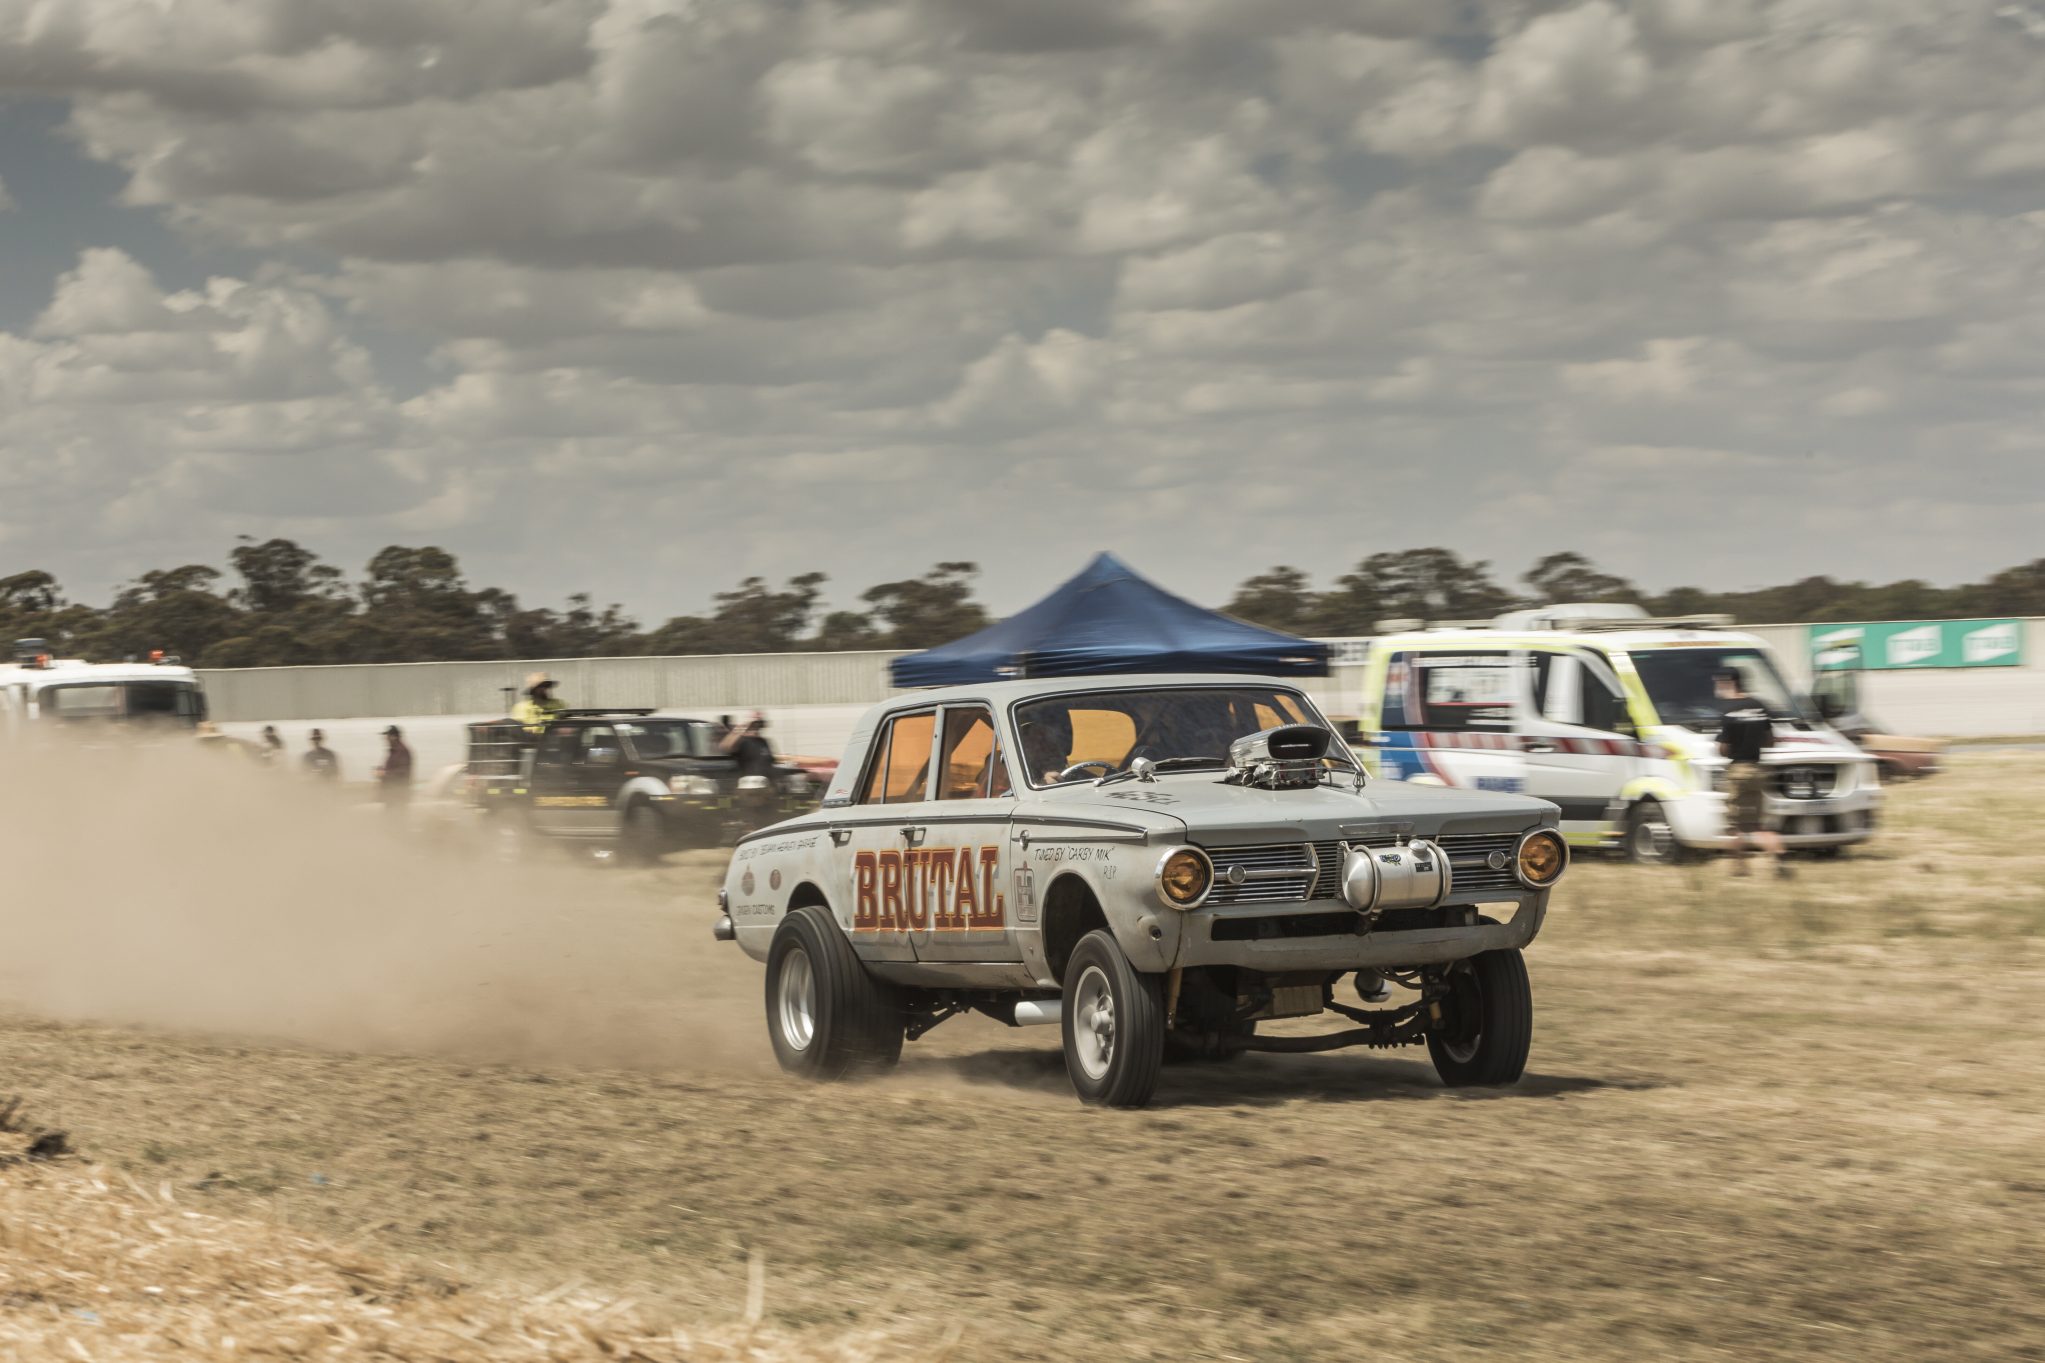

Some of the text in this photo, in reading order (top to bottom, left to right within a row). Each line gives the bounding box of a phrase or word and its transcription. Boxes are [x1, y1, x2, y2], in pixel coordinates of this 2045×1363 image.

[1034, 848, 1054, 861] TUNED
[1055, 847, 1065, 861] BY
[854, 846, 1005, 932] BRUTAL
